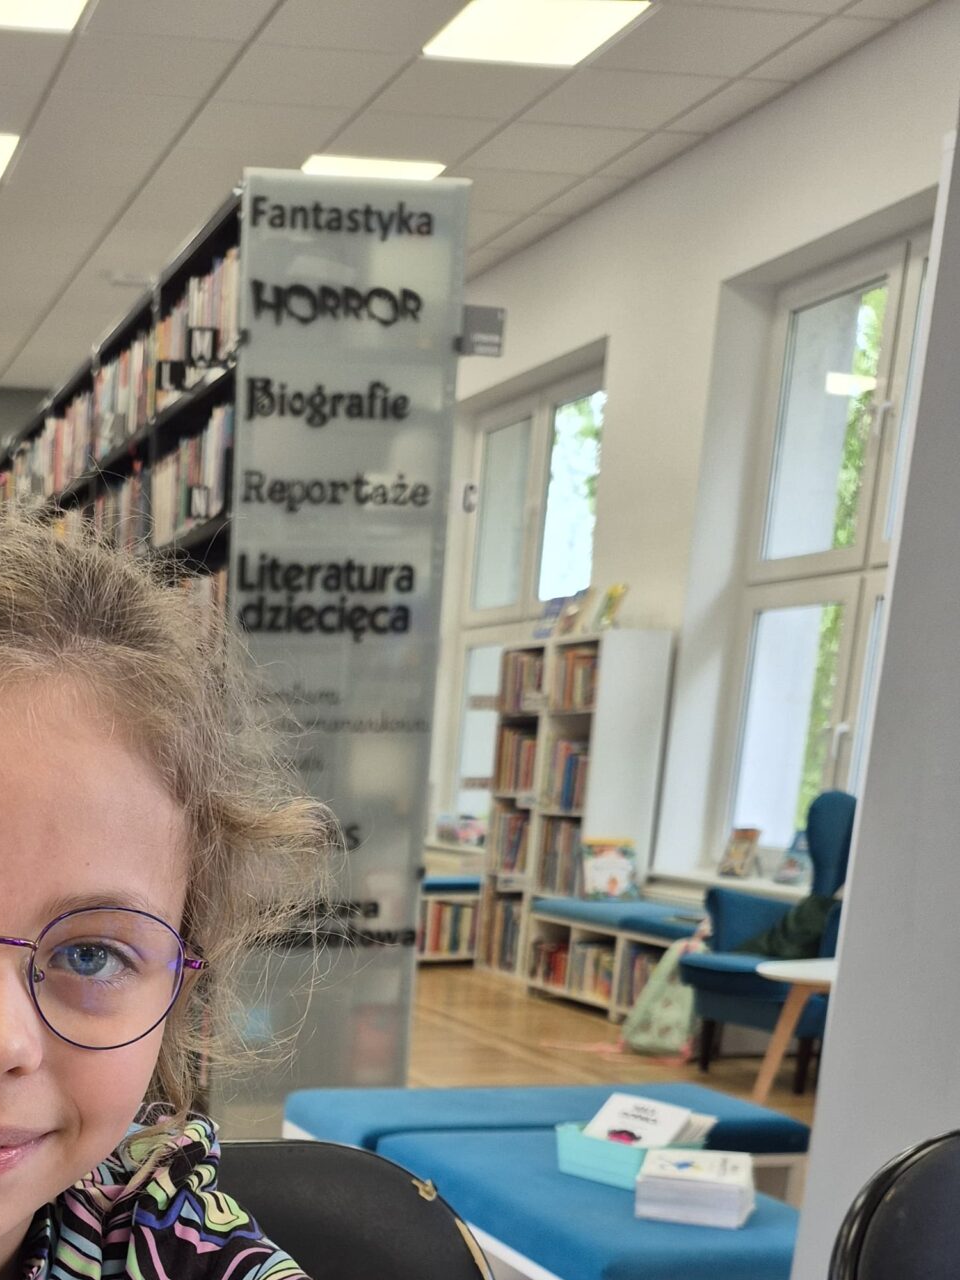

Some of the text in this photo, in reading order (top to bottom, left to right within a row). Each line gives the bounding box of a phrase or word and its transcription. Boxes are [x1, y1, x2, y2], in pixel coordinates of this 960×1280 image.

[250, 196, 435, 242] Fantastyka
[250, 279, 423, 326] HORROR
[245, 376, 411, 428] Biografie
[242, 469, 431, 514] Reportaże
[237, 552, 415, 594] Literatura
[238, 597, 411, 643] dziecięca
